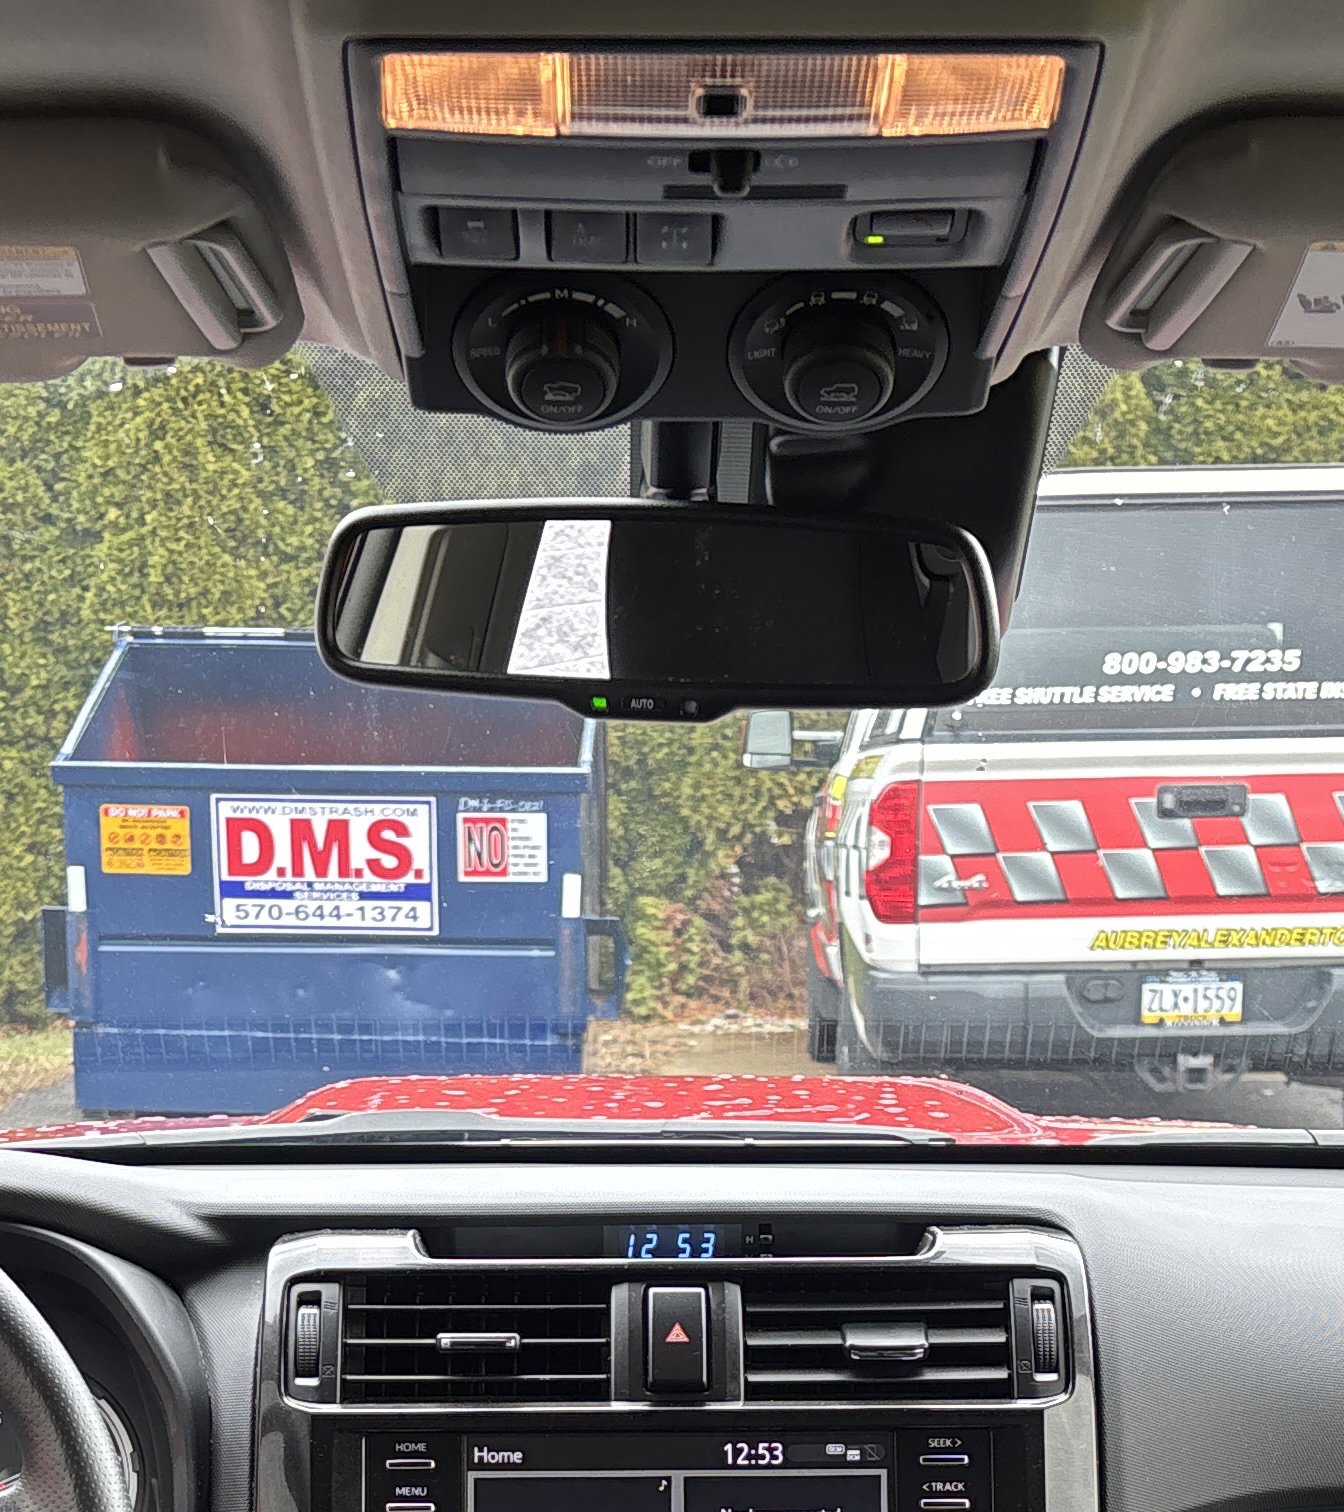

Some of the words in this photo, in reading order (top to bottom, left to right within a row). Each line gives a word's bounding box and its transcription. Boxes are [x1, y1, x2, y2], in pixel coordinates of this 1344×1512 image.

[555, 288, 569, 299] M
[815, 405, 858, 415] ON/OFF
[1102, 649, 1302, 675] 800-983-7235
[1013, 685, 1097, 705] SHUTTLE
[1097, 683, 1176, 703] SERVICE
[1212, 682, 1261, 701] FREE
[1261, 681, 1320, 700] STATE
[630, 698, 654, 710] AUTO
[230, 805, 419, 818] WWW.DMSTRASH.COM
[225, 816, 424, 880] D.M.S.
[463, 822, 508, 872] NO
[244, 881, 310, 891] DISPOSAL
[313, 881, 406, 892] MANAGEMENT
[293, 891, 360, 901] SERVICES
[235, 903, 420, 923] 570-644-1374
[395, 1442, 427, 1452] HOME
[928, 1438, 953, 1448] SEEK
[473, 1446, 524, 1464] Home
[723, 1442, 784, 1466] 12:53
[395, 1486, 428, 1496] MENU
[931, 1482, 966, 1492] TRACK
